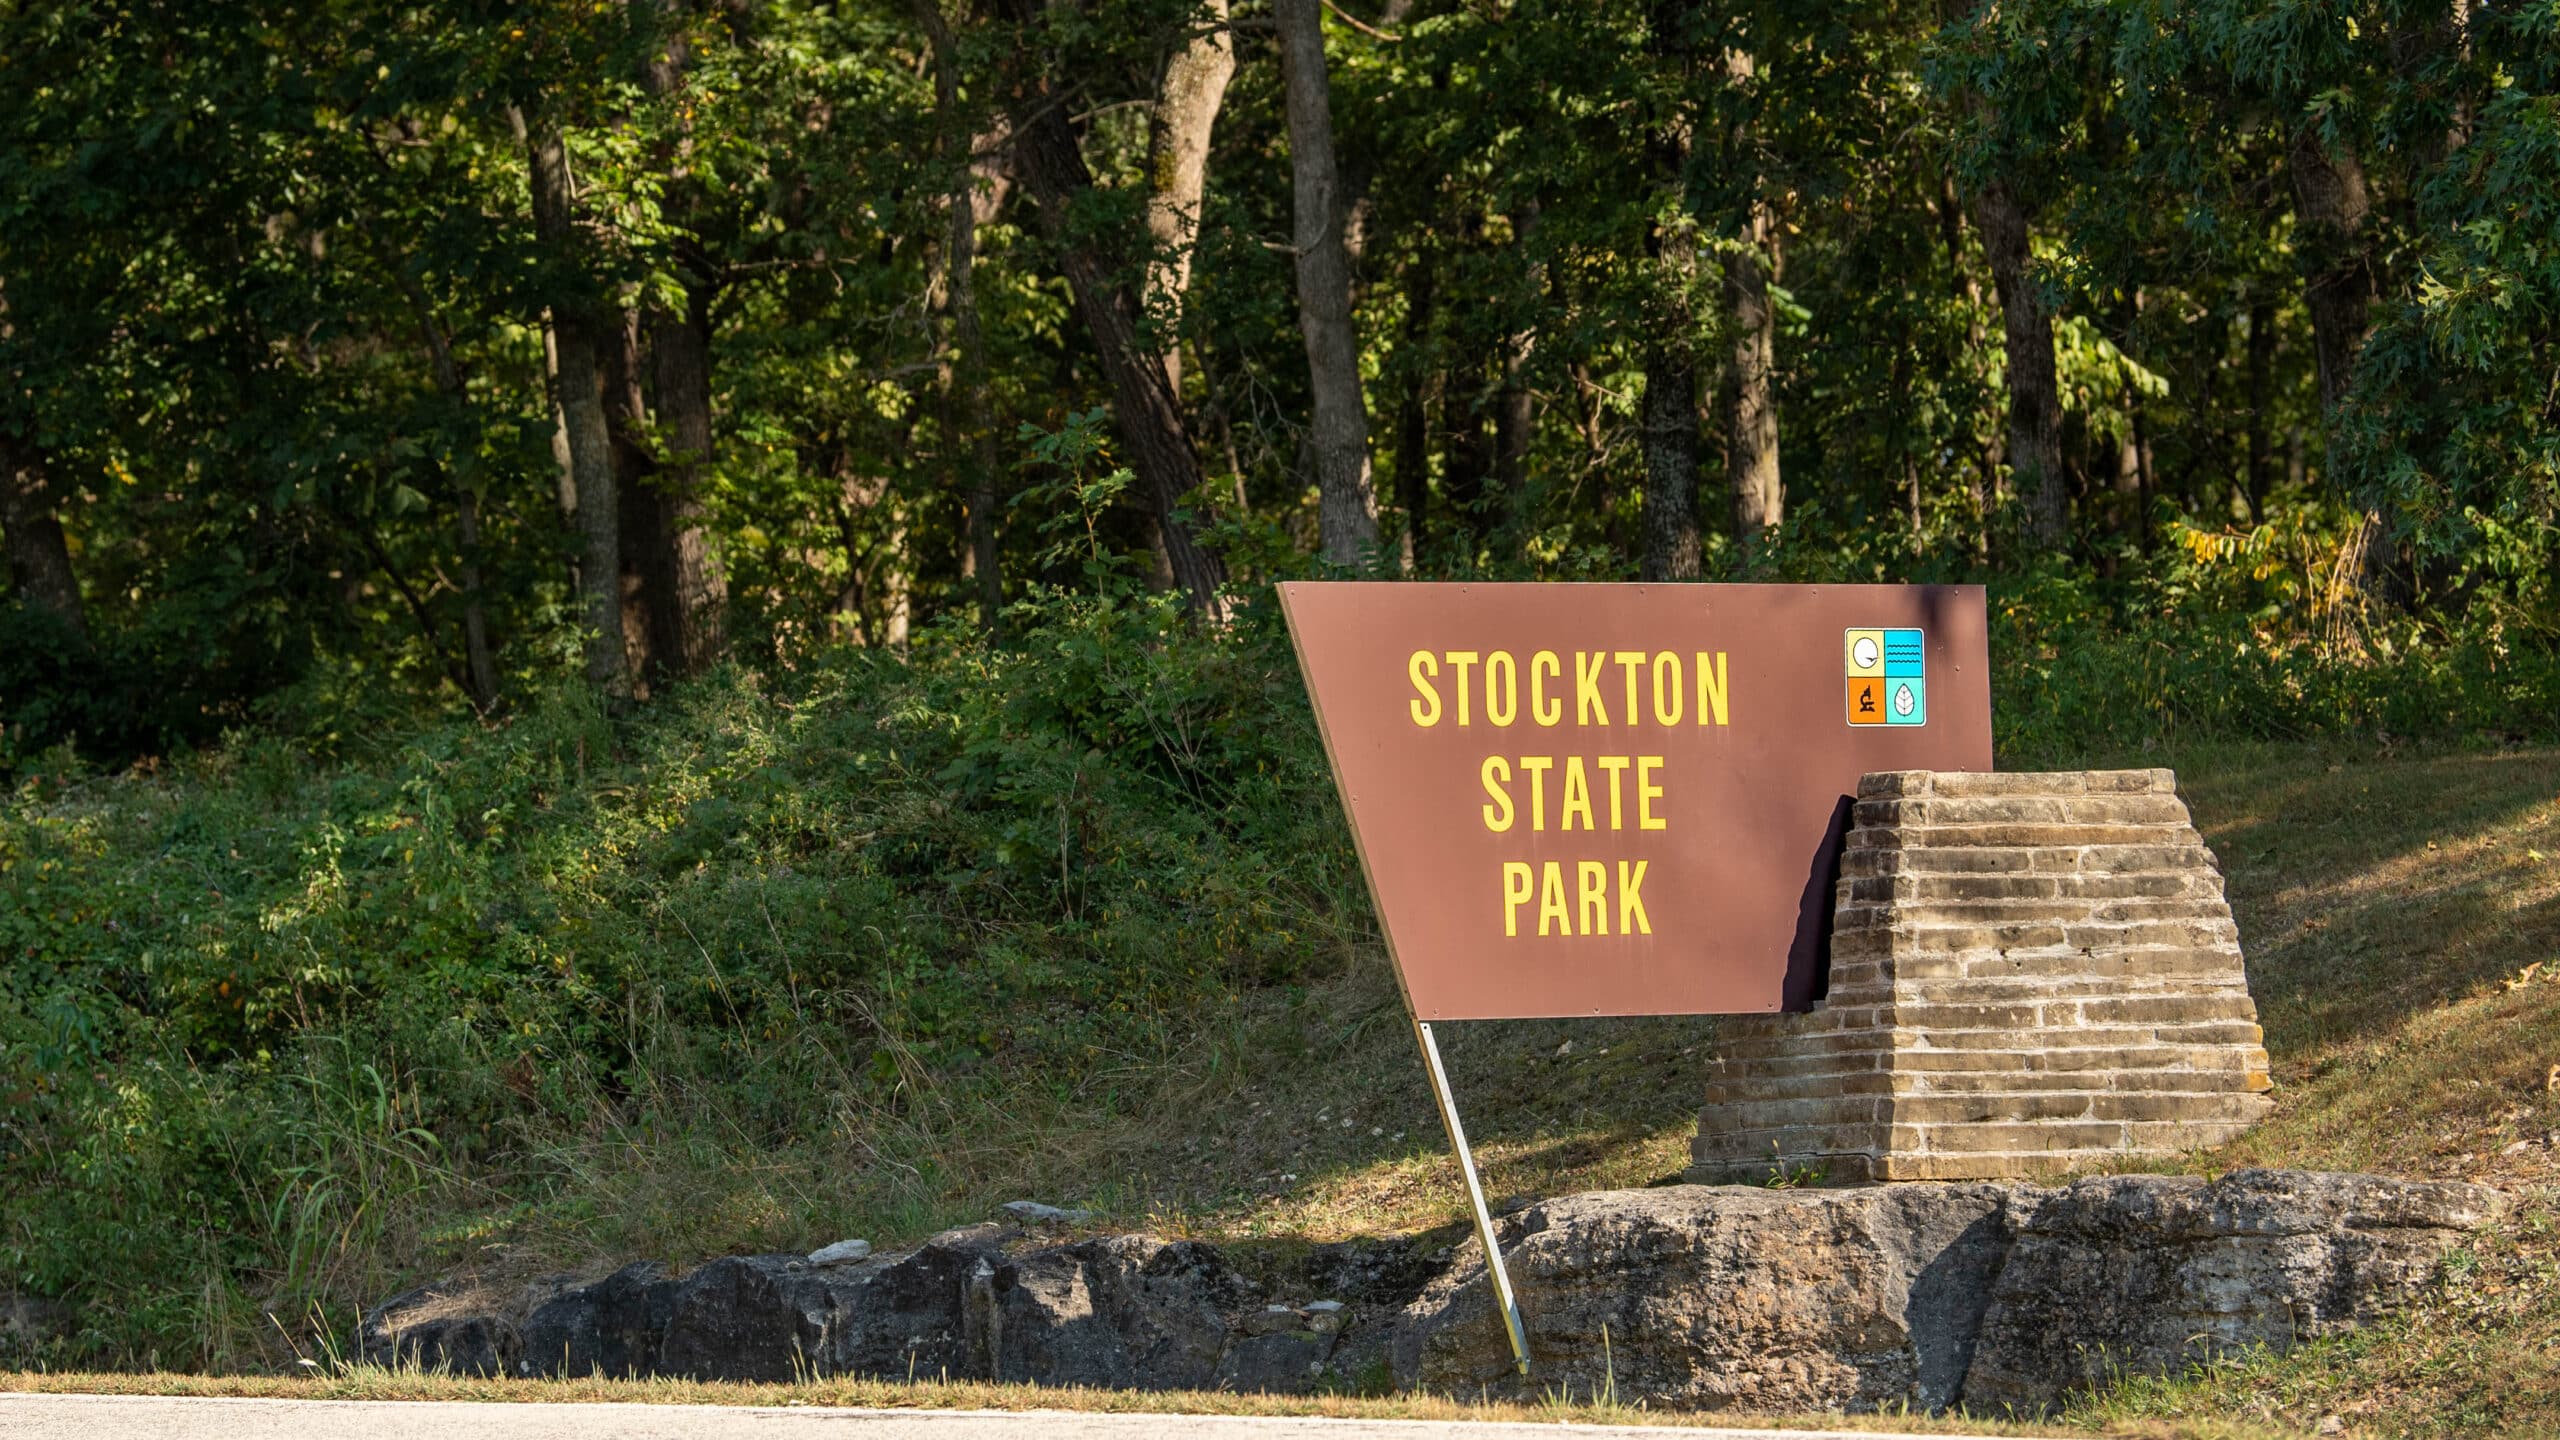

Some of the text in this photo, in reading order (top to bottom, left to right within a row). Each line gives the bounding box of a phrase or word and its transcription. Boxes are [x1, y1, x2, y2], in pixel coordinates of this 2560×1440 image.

[1408, 649, 1730, 728] STOCKTON
[1480, 755, 1668, 833] STATE
[1503, 859, 1653, 938] PARK
